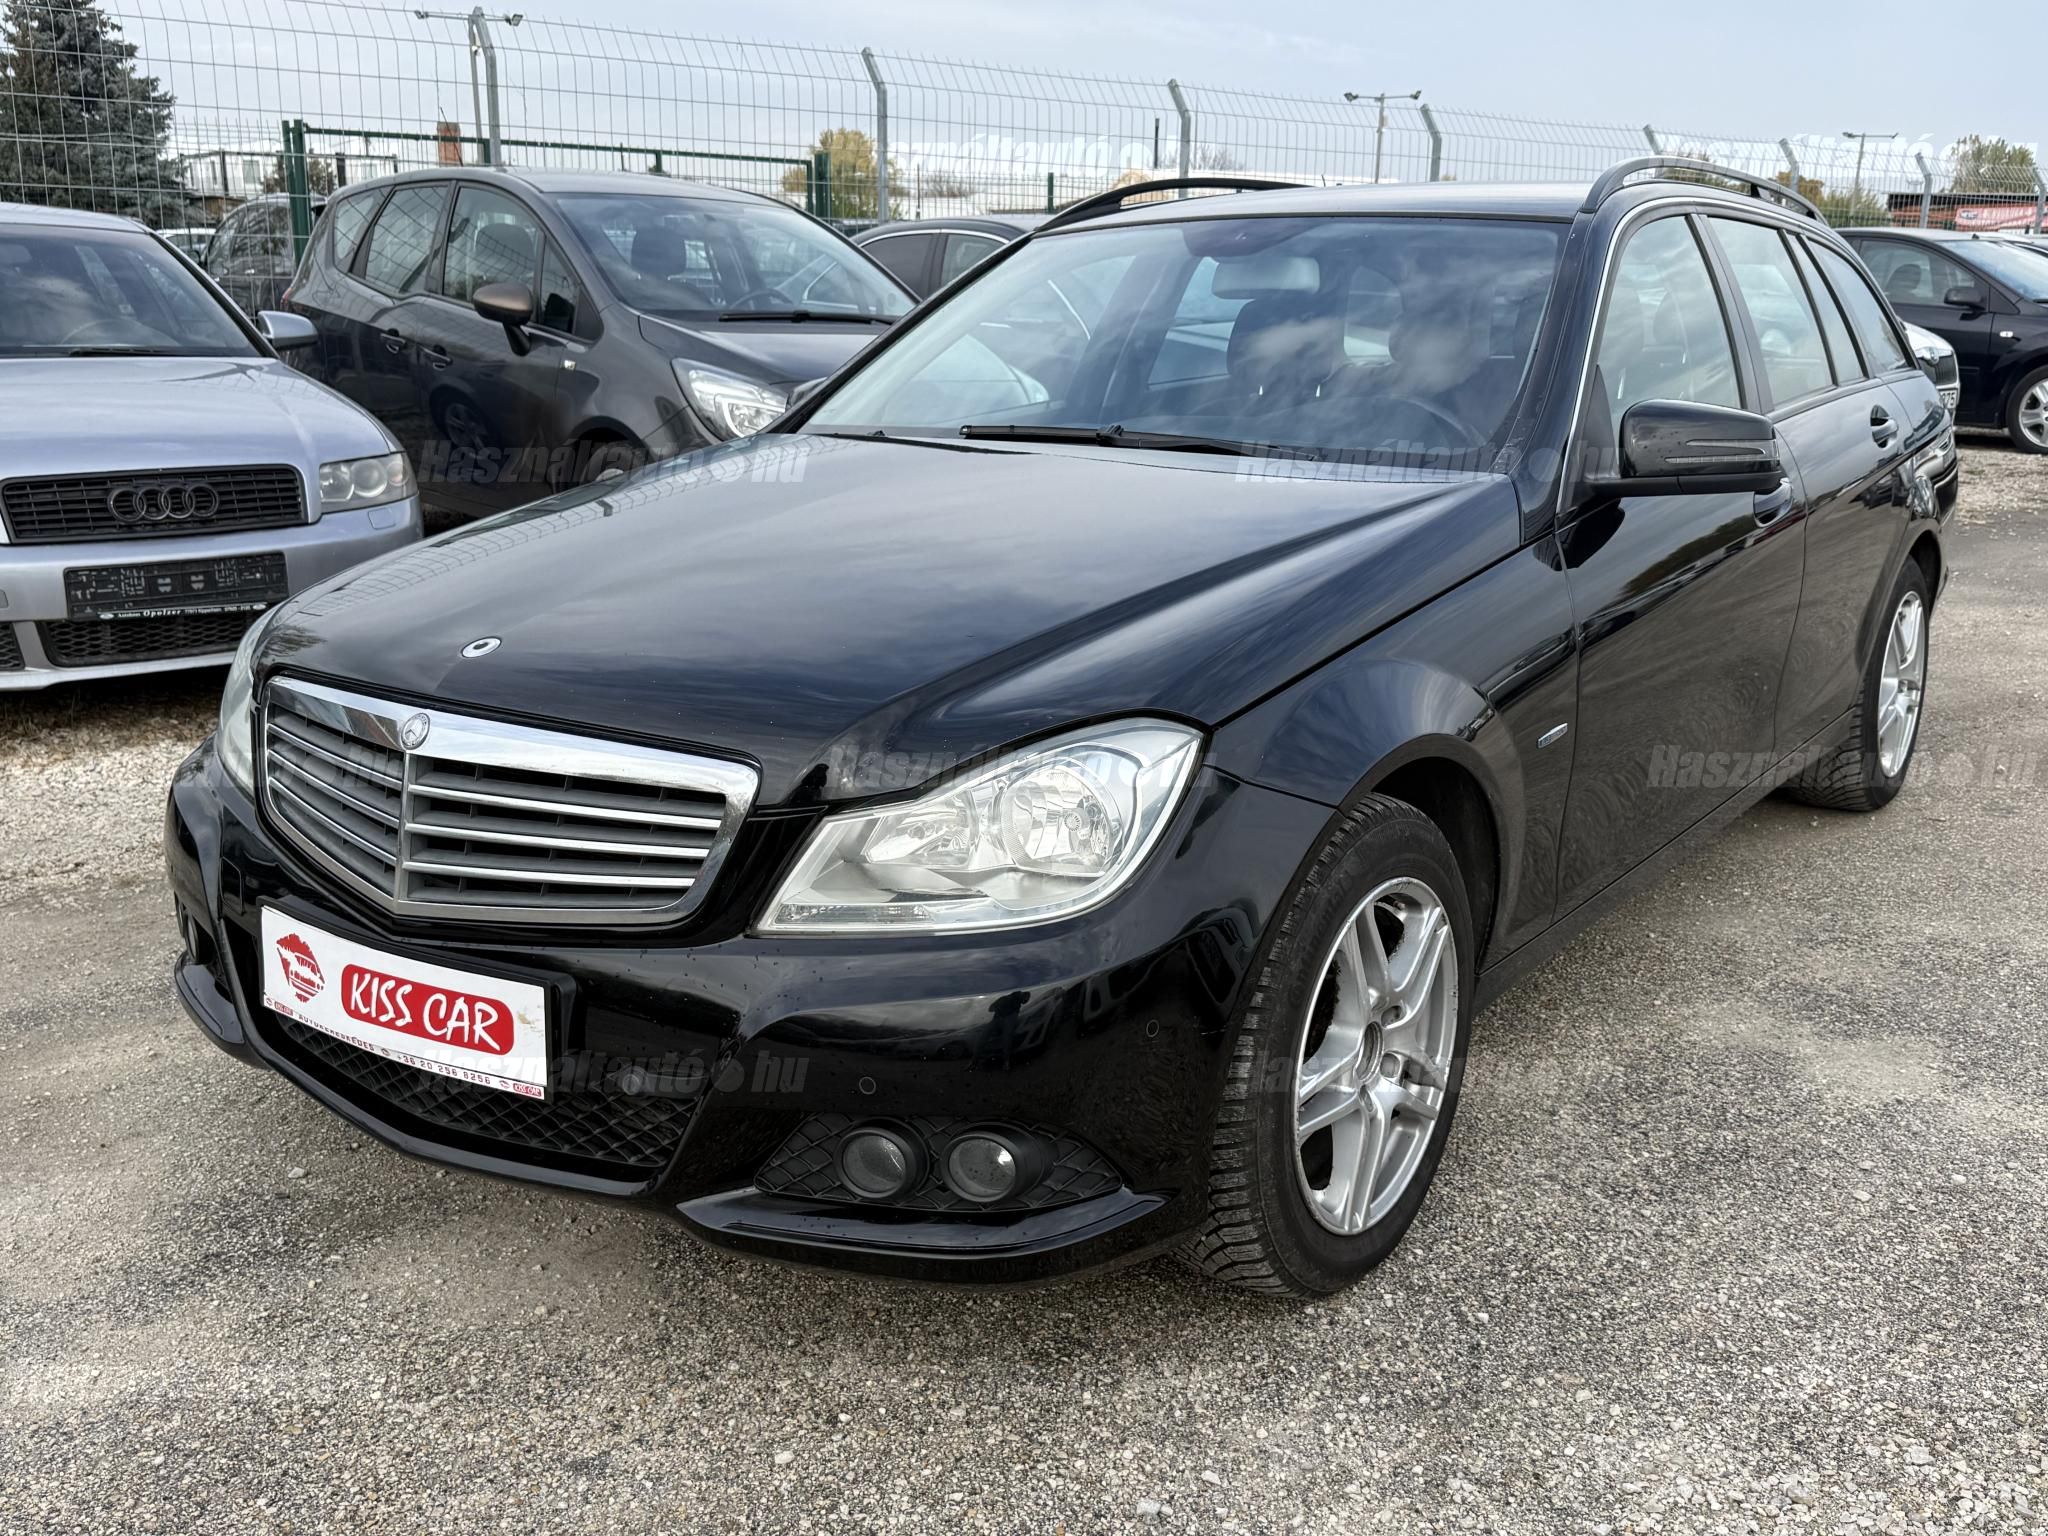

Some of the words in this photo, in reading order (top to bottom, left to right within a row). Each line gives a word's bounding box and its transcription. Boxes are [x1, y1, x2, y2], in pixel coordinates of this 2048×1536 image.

[351, 971, 413, 1027] KISS
[423, 993, 500, 1051] CAR
[420, 1060, 433, 1070] 20
[438, 1065, 458, 1076] 256
[463, 1071, 491, 1084] 8256
